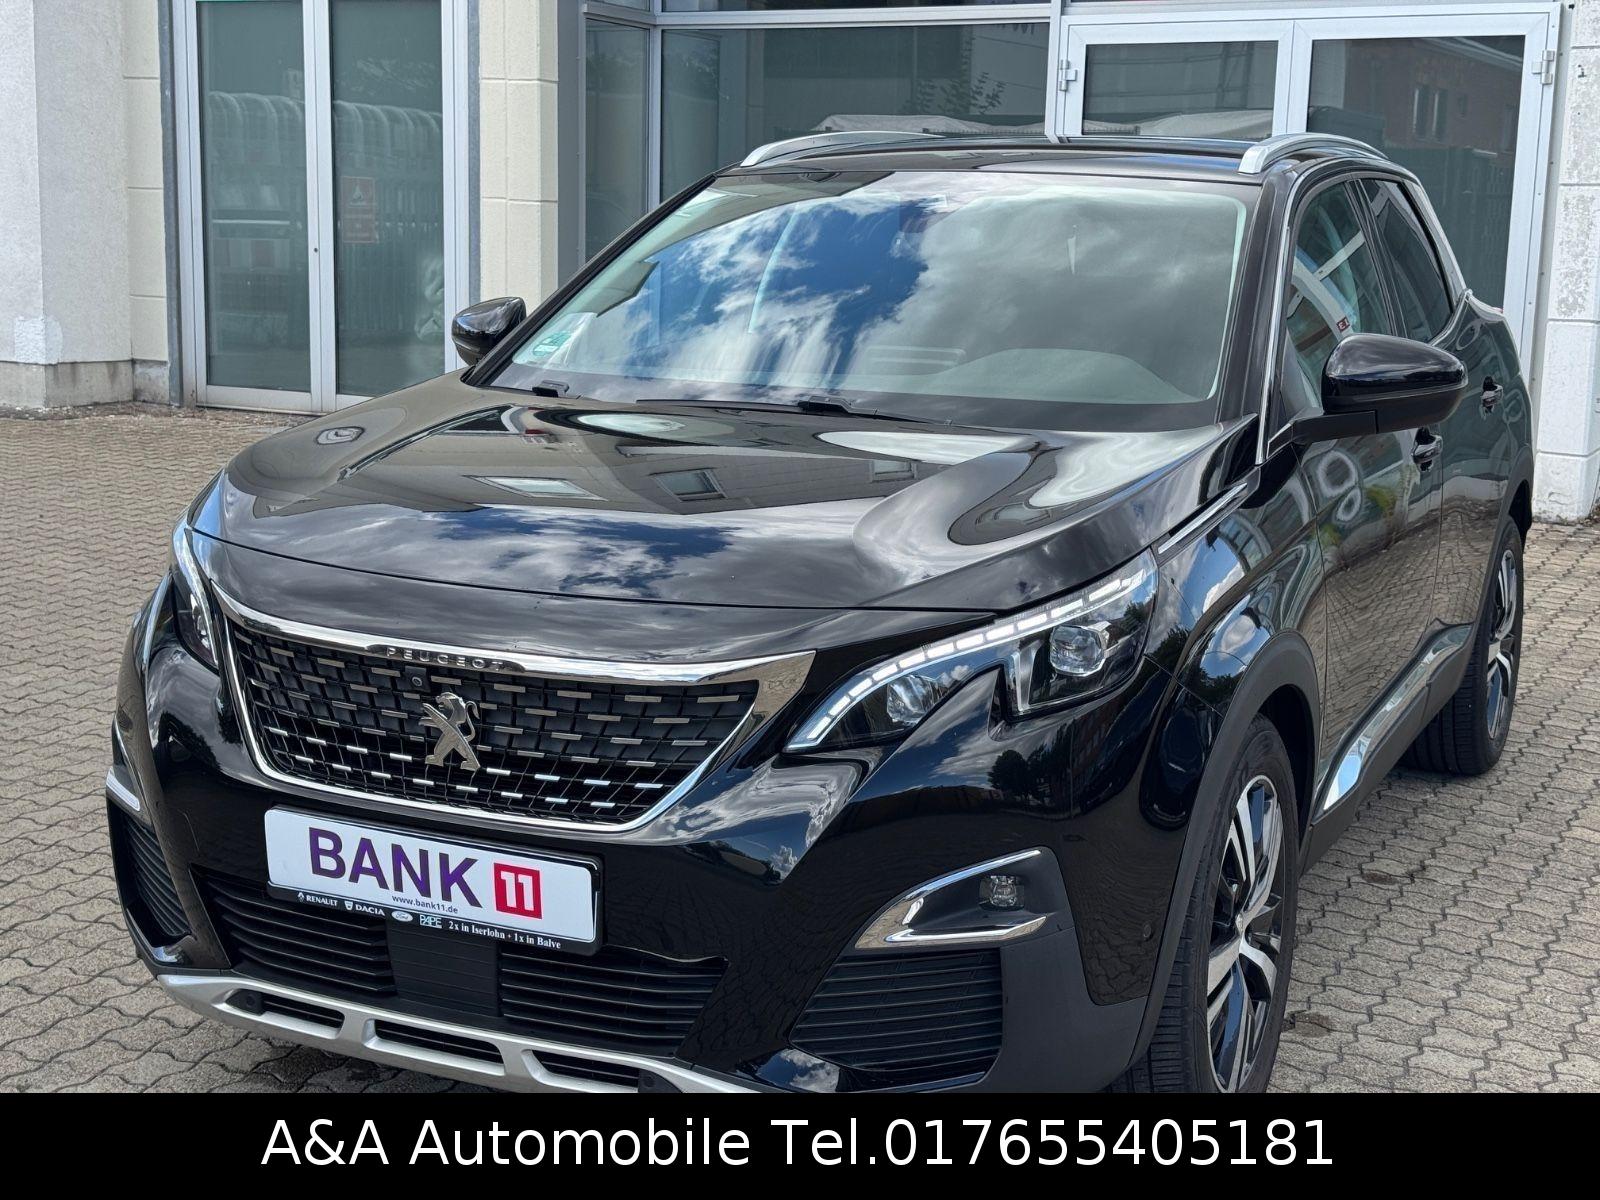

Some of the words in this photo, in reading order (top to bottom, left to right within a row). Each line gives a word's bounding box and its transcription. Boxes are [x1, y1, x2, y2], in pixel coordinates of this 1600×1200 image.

[386, 646, 504, 671] PEUGEOT
[308, 826, 483, 909] BANK
[500, 871, 535, 911] 11
[306, 894, 338, 907] RENAULT
[355, 904, 385, 917] DACIA
[419, 914, 442, 929] PAPE
[448, 920, 459, 931] 2x
[461, 924, 470, 933] in
[472, 925, 505, 940] Iserlohn
[514, 932, 525, 943] 1x
[526, 935, 535, 945] in
[537, 936, 561, 949] Balve
[391, 894, 458, 914] www.bank11.de
